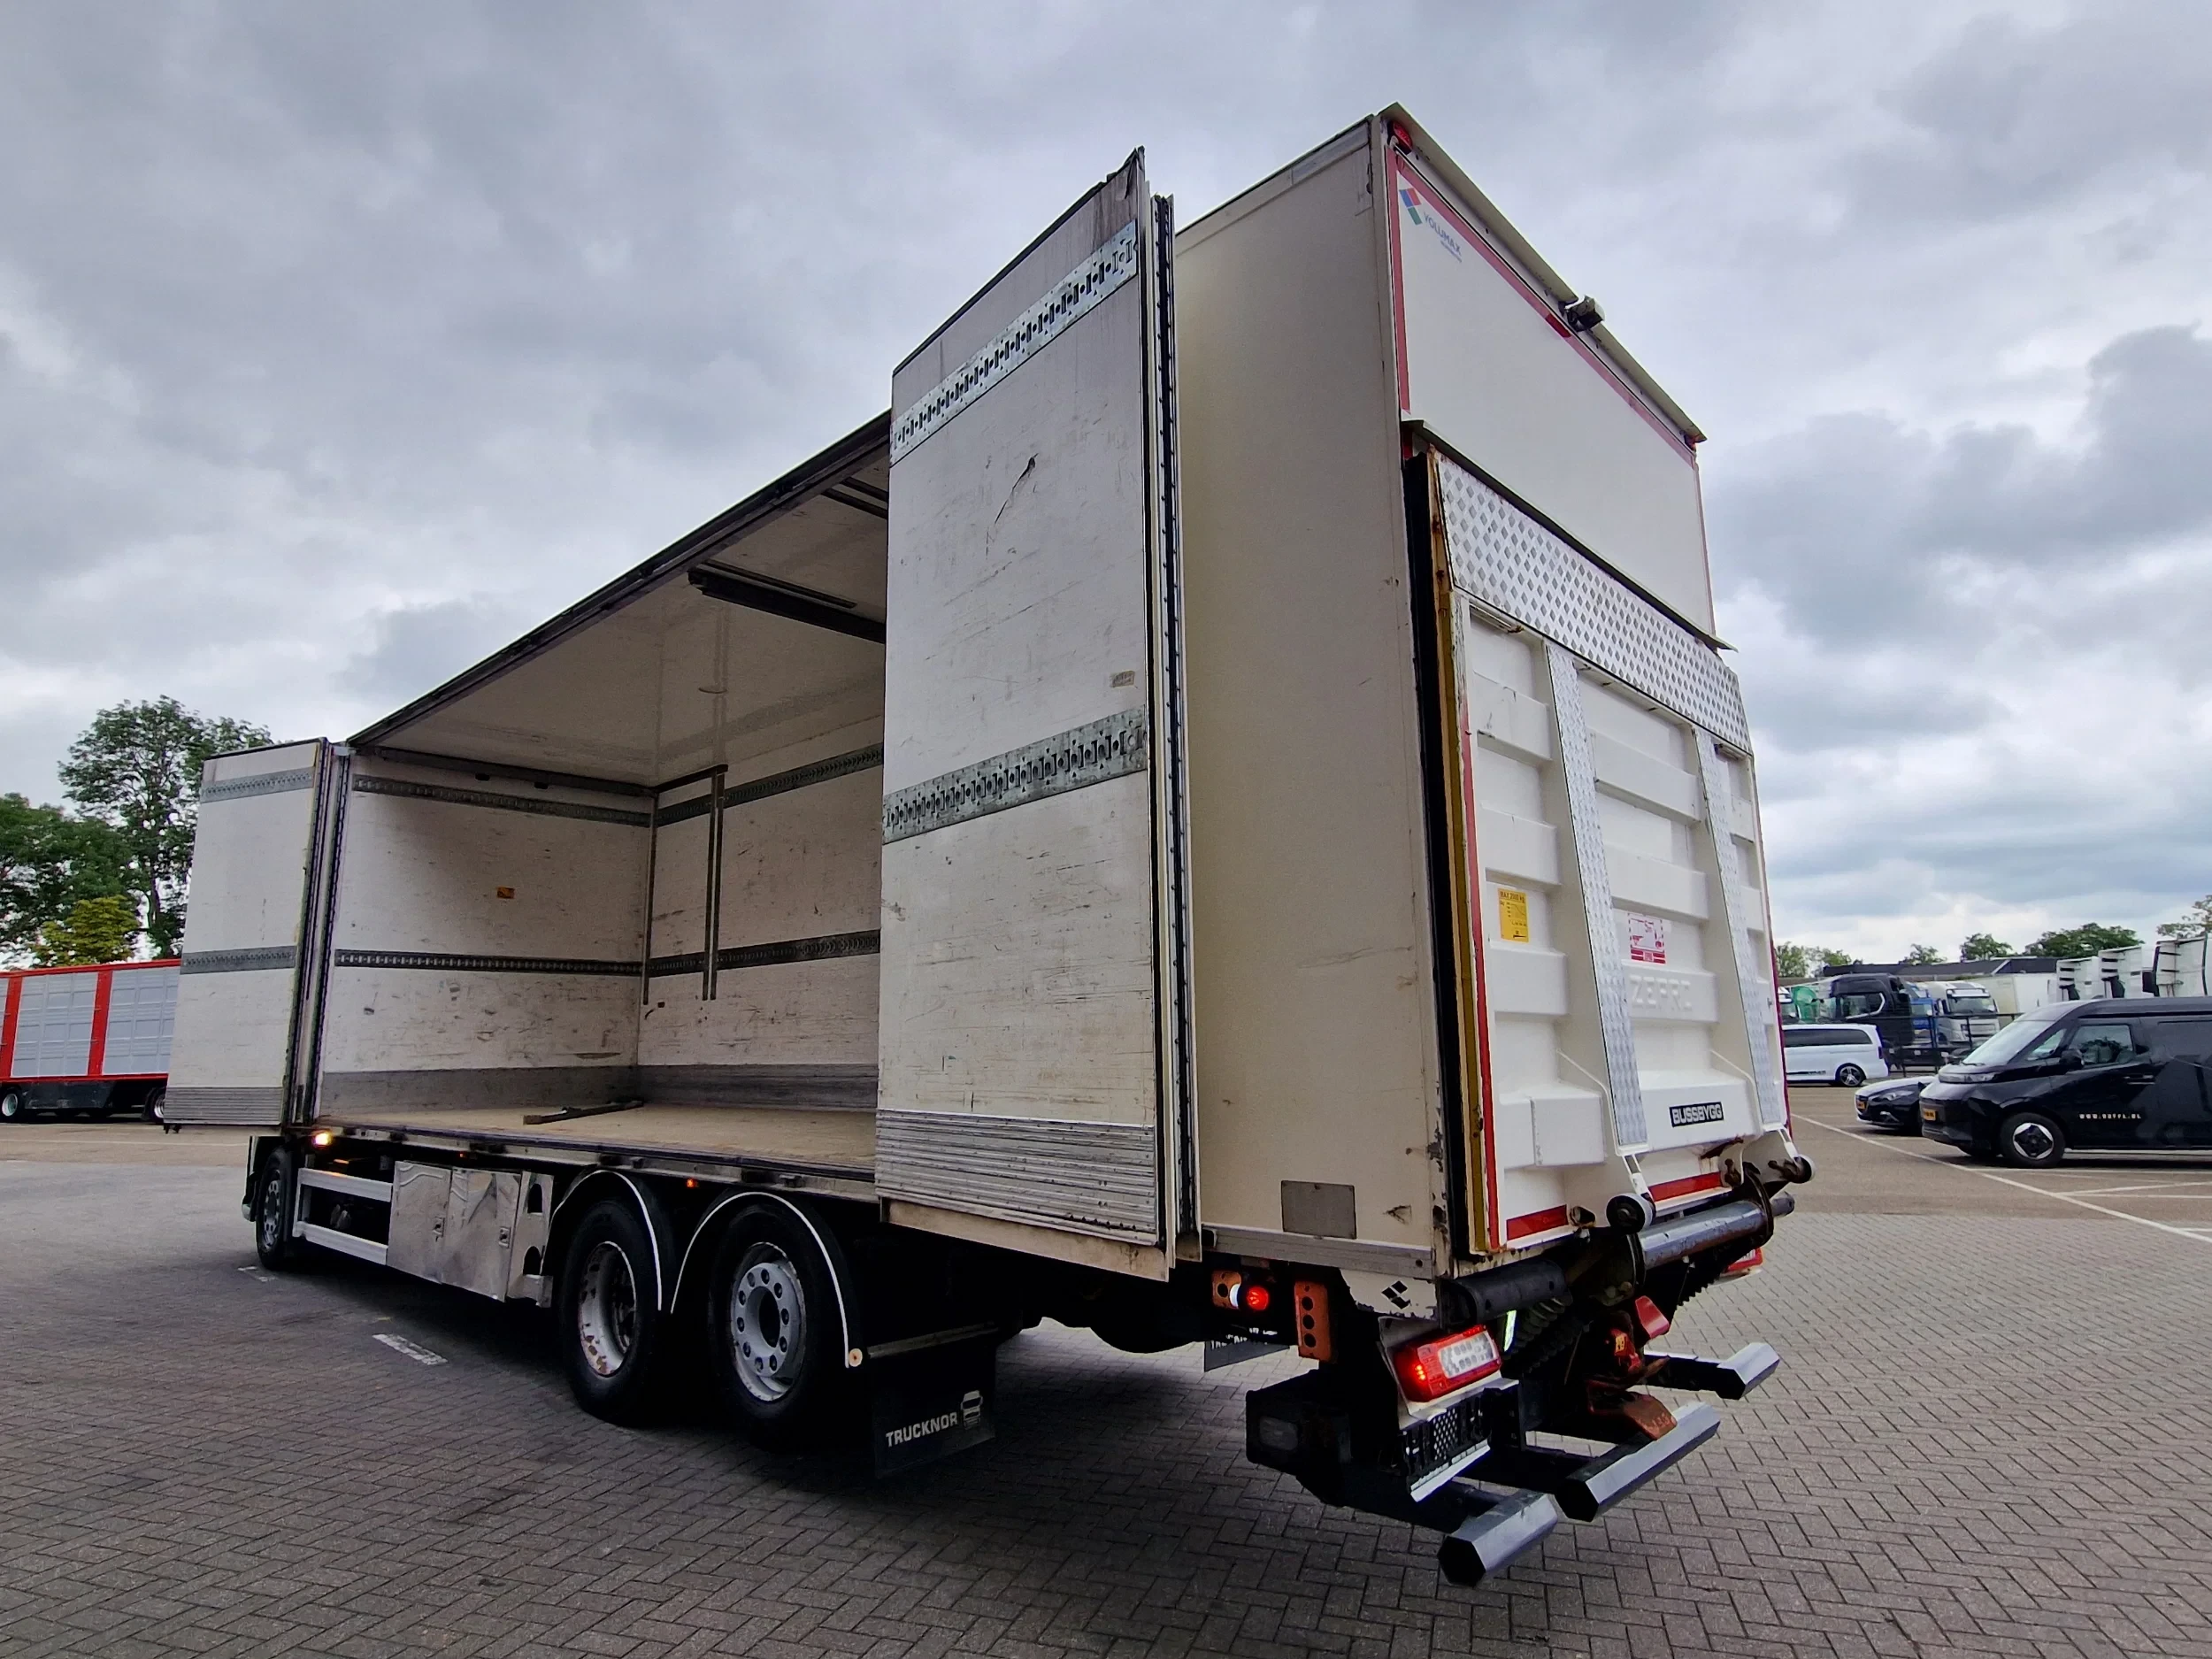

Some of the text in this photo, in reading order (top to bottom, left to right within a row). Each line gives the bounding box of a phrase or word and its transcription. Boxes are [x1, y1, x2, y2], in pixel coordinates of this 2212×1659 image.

[1423, 211, 1462, 257] VOLUMAX
[1671, 1103, 1723, 1125] BUSSBYGG
[885, 1411, 958, 1448] TRUCKNOR
